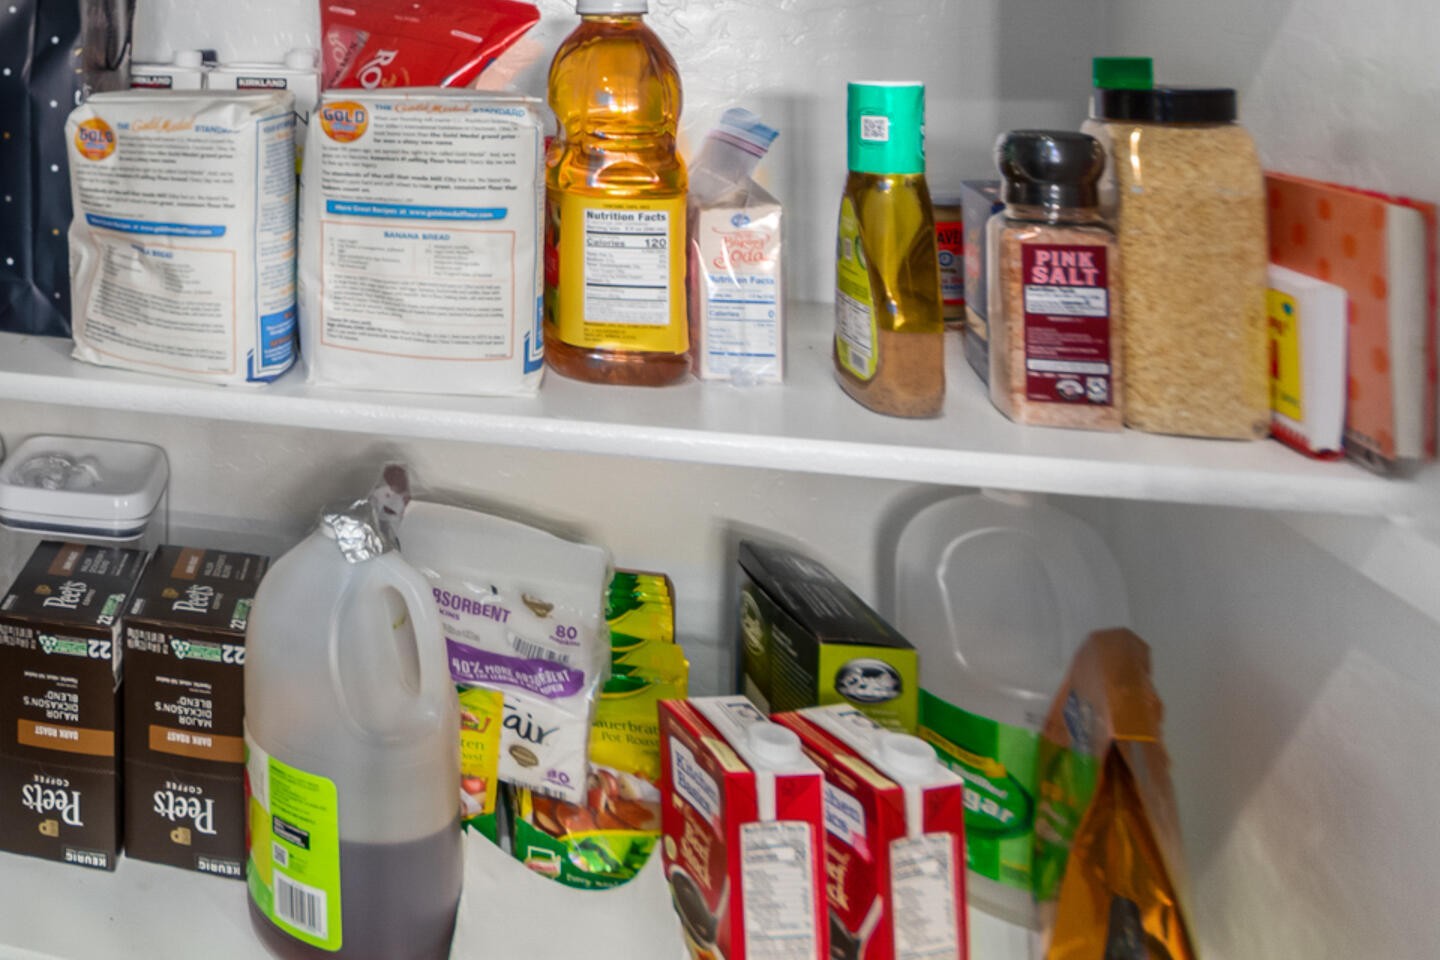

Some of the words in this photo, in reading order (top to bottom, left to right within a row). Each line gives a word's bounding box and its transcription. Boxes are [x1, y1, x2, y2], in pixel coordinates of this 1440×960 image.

[238, 77, 287, 89] KIRKLAND
[323, 108, 366, 124] GOLD
[79, 127, 113, 143] GOLD
[586, 210, 635, 221] Nutrition
[638, 212, 667, 222] Facts
[421, 232, 451, 241] BREAD
[586, 238, 626, 248] Calories
[645, 238, 667, 249] 120
[1034, 249, 1096, 268] PINK
[1031, 266, 1101, 287] SALT
[555, 624, 578, 640] 80
[87, 639, 112, 660] 22
[221, 644, 246, 665] 22
[23, 695, 79, 712] DICKASON'S
[46, 690, 79, 703] BLEND
[177, 695, 213, 709] BLEND
[46, 709, 79, 722] MAJOR
[154, 701, 213, 719] DICKASON'S
[178, 715, 213, 728] MAJOR
[34, 725, 55, 738] ROAST
[56, 727, 79, 741] DARK
[166, 730, 188, 744] ROAST
[188, 733, 213, 748] DARK
[33, 773, 70, 787] COFFEE
[165, 780, 203, 795] COFFEE
[22, 783, 84, 827] Peet's
[153, 789, 218, 836] Peet's
[64, 850, 107, 868] KEURIG
[198, 855, 241, 876] KEURIG
